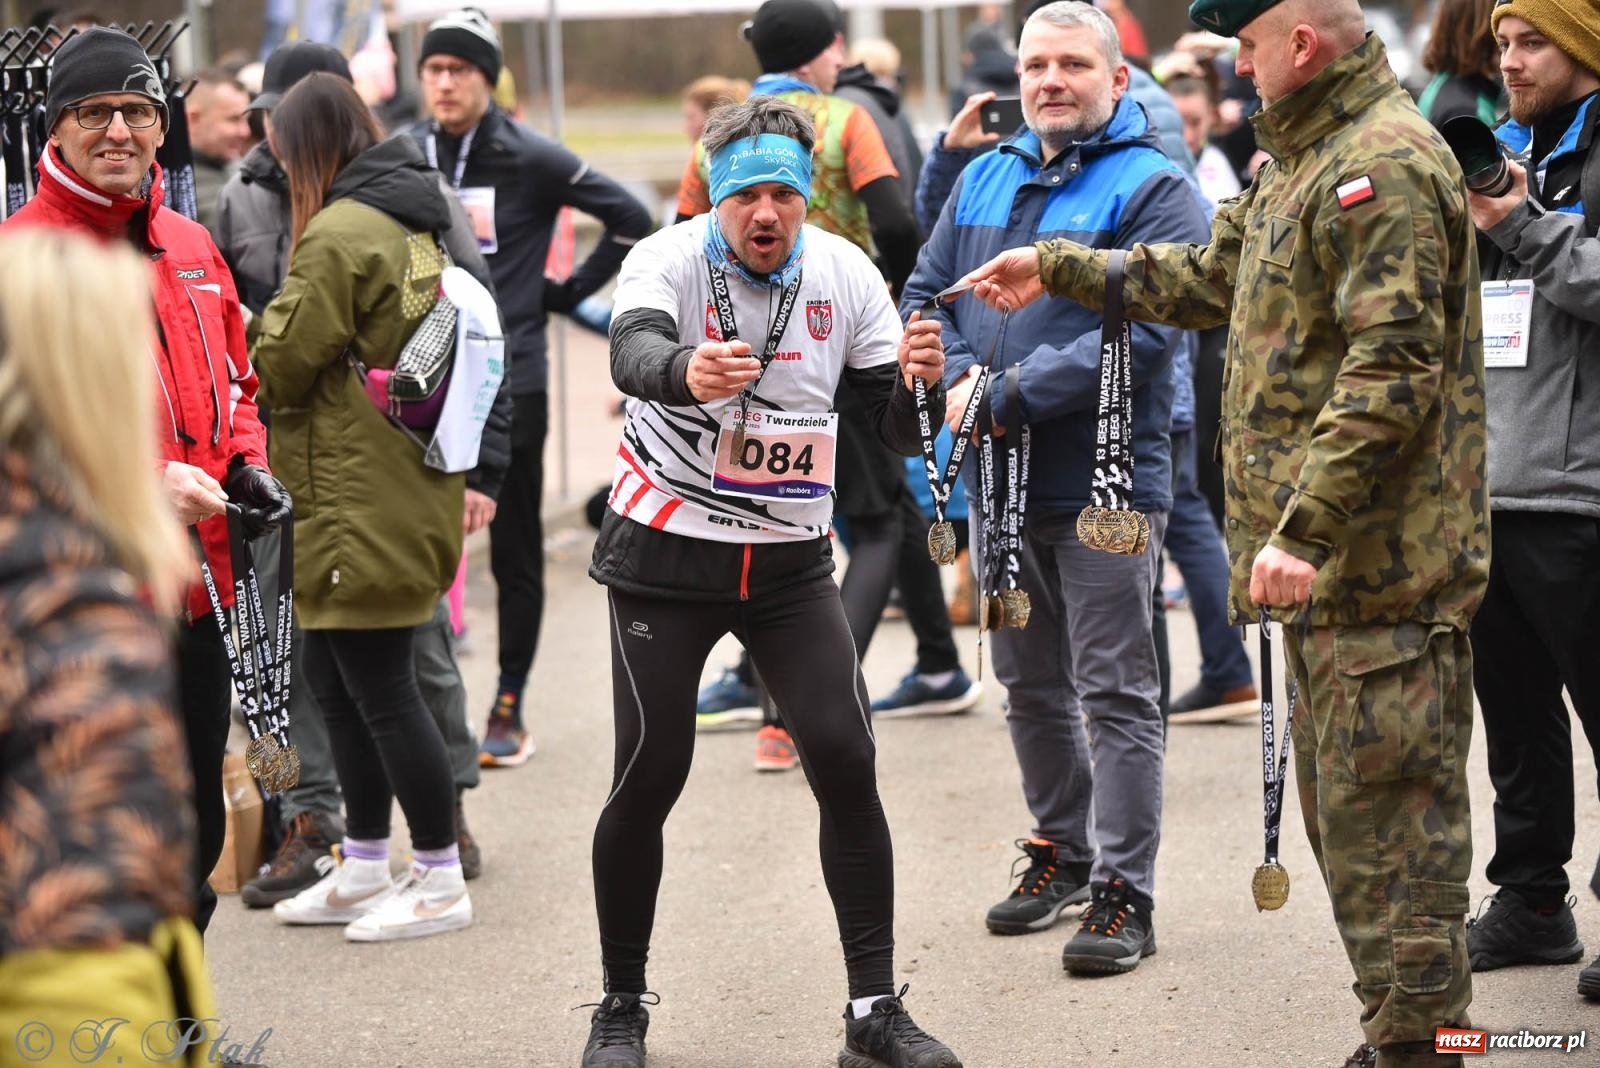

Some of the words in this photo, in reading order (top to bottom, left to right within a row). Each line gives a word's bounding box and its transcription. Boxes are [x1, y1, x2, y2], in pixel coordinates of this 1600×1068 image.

[711, 266, 735, 332] 3.02.2025
[765, 414, 828, 428] Twardziela
[924, 440, 933, 454] 13
[1110, 443, 1120, 458] 13
[740, 438, 814, 476] 084
[1096, 449, 1106, 462] 13
[947, 466, 958, 478] 13
[245, 677, 255, 691] 13
[1262, 702, 1274, 784] 23.02.2025
